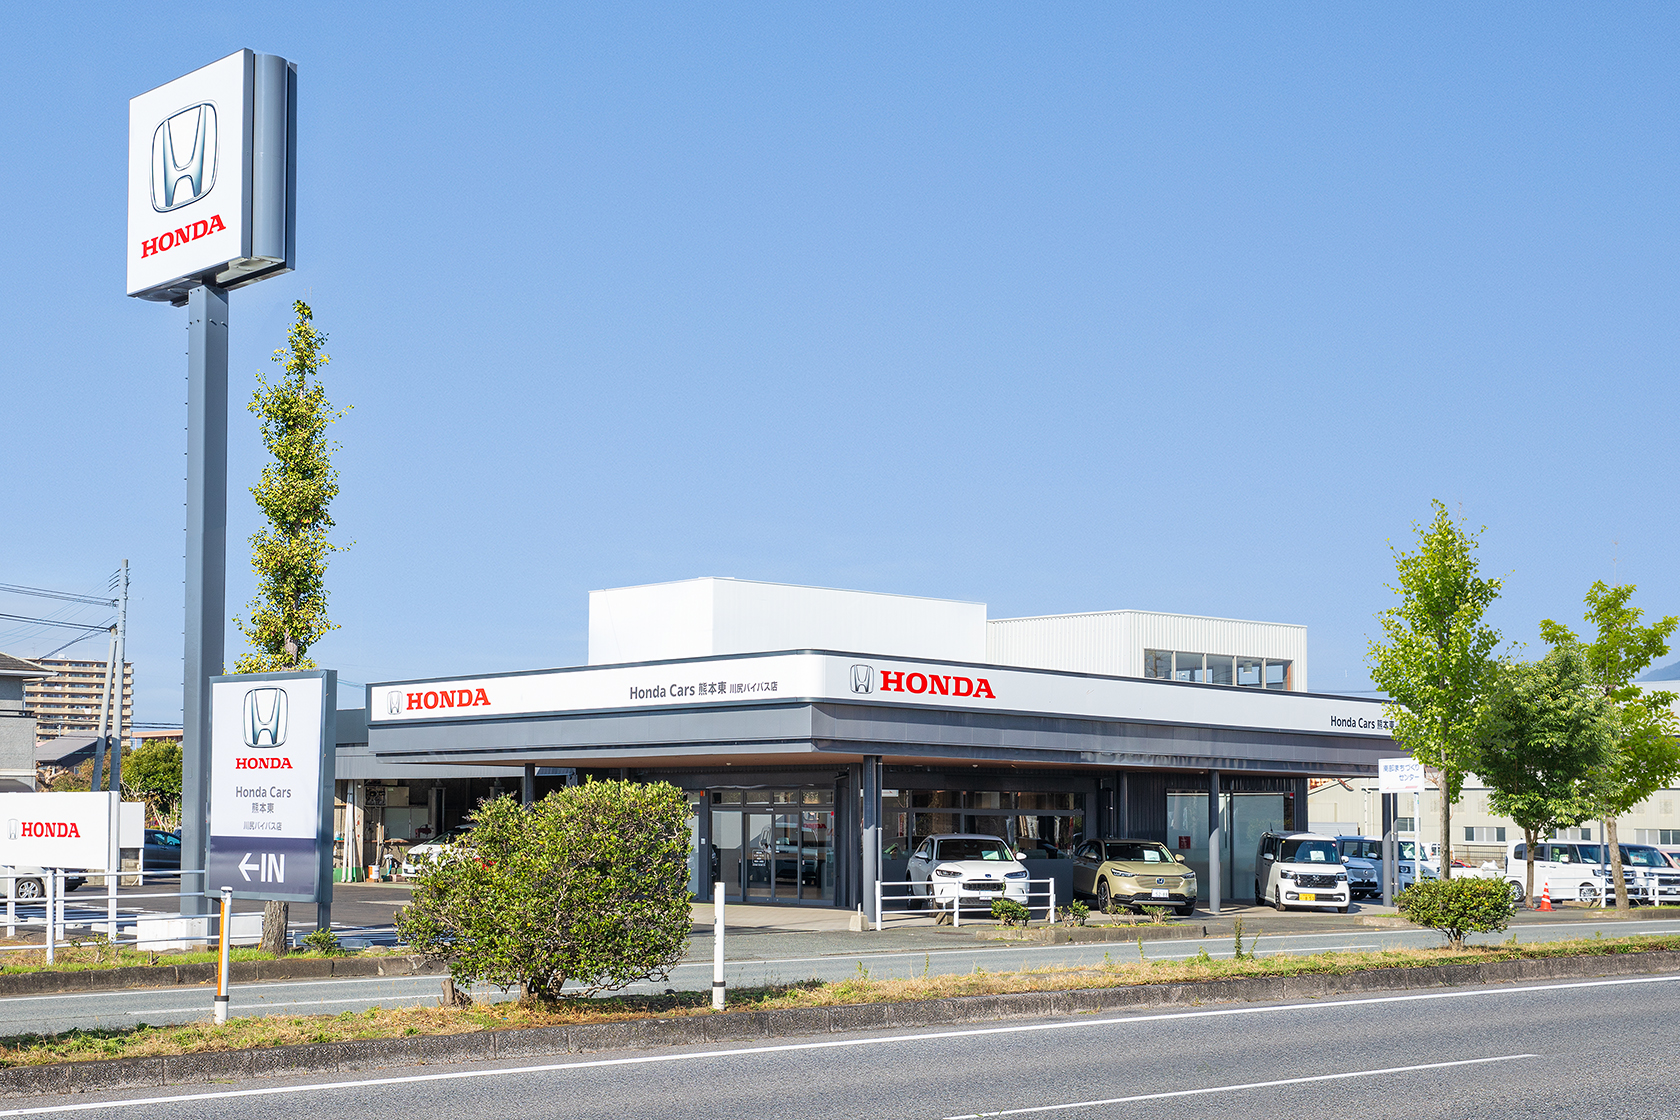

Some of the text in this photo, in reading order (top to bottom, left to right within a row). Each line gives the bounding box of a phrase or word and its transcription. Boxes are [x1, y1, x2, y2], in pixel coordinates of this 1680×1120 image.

[141, 215, 227, 258] HONDA
[630, 685, 666, 699] Honda
[669, 684, 695, 697] Cars
[698, 681, 727, 696] 熊本東
[879, 671, 997, 700] HONDA
[407, 687, 491, 711] HONDA
[1330, 715, 1357, 728] Honda
[1358, 717, 1376, 729] Cars
[235, 757, 294, 770] HONDA
[1398, 773, 1420, 782] センター
[235, 786, 292, 798] Honda Cars
[251, 802, 275, 814] 熊本東
[21, 821, 81, 838] HONDA
[260, 853, 286, 884] IN
